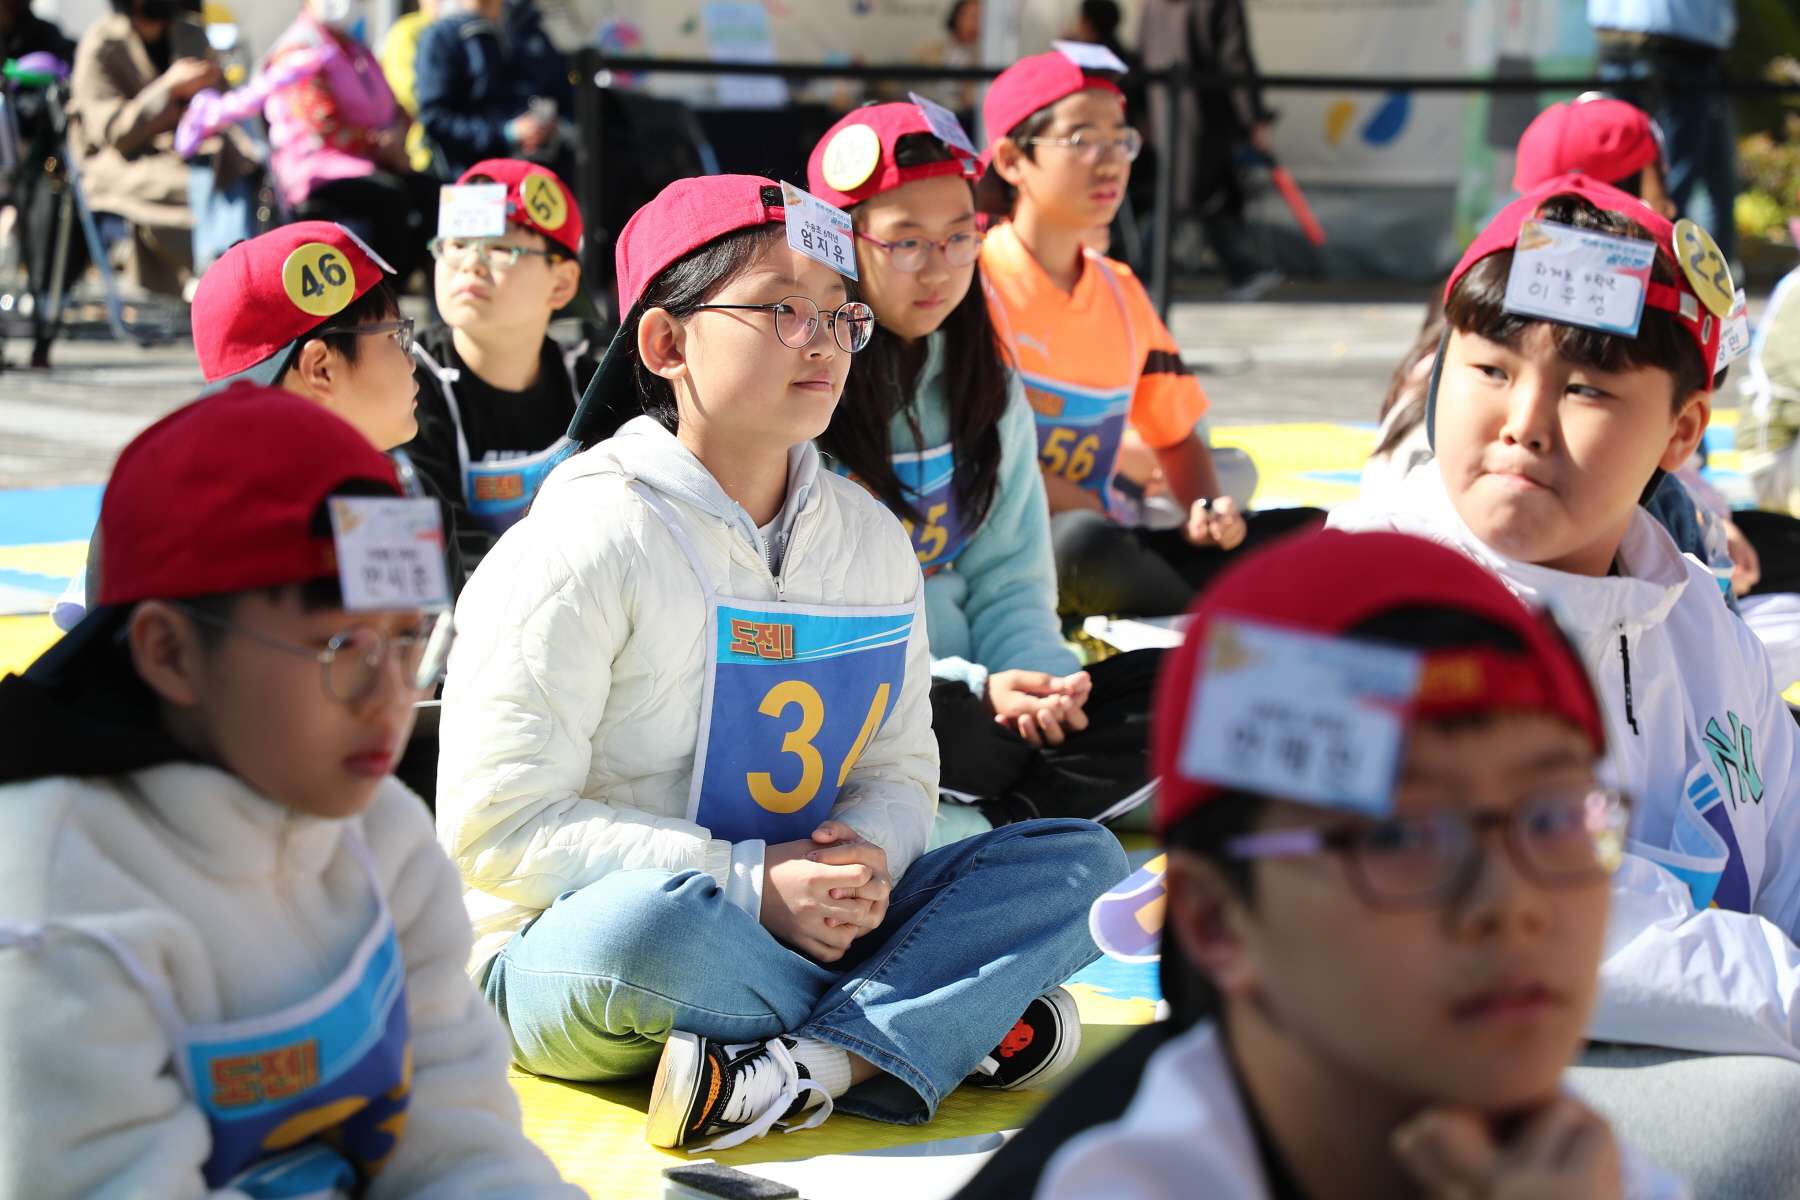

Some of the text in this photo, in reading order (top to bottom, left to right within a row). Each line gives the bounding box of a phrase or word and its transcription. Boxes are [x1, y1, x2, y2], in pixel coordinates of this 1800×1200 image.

[530, 180, 558, 221] 57
[801, 228, 845, 264] 엄지유
[804, 220, 839, 244] 수송초 6학년
[302, 253, 347, 298] 46
[1685, 233, 1731, 299] 22
[1528, 282, 1605, 316] 이유성
[1039, 427, 1100, 483] 56
[730, 617, 793, 660] 도전!
[1702, 710, 1763, 811] NY
